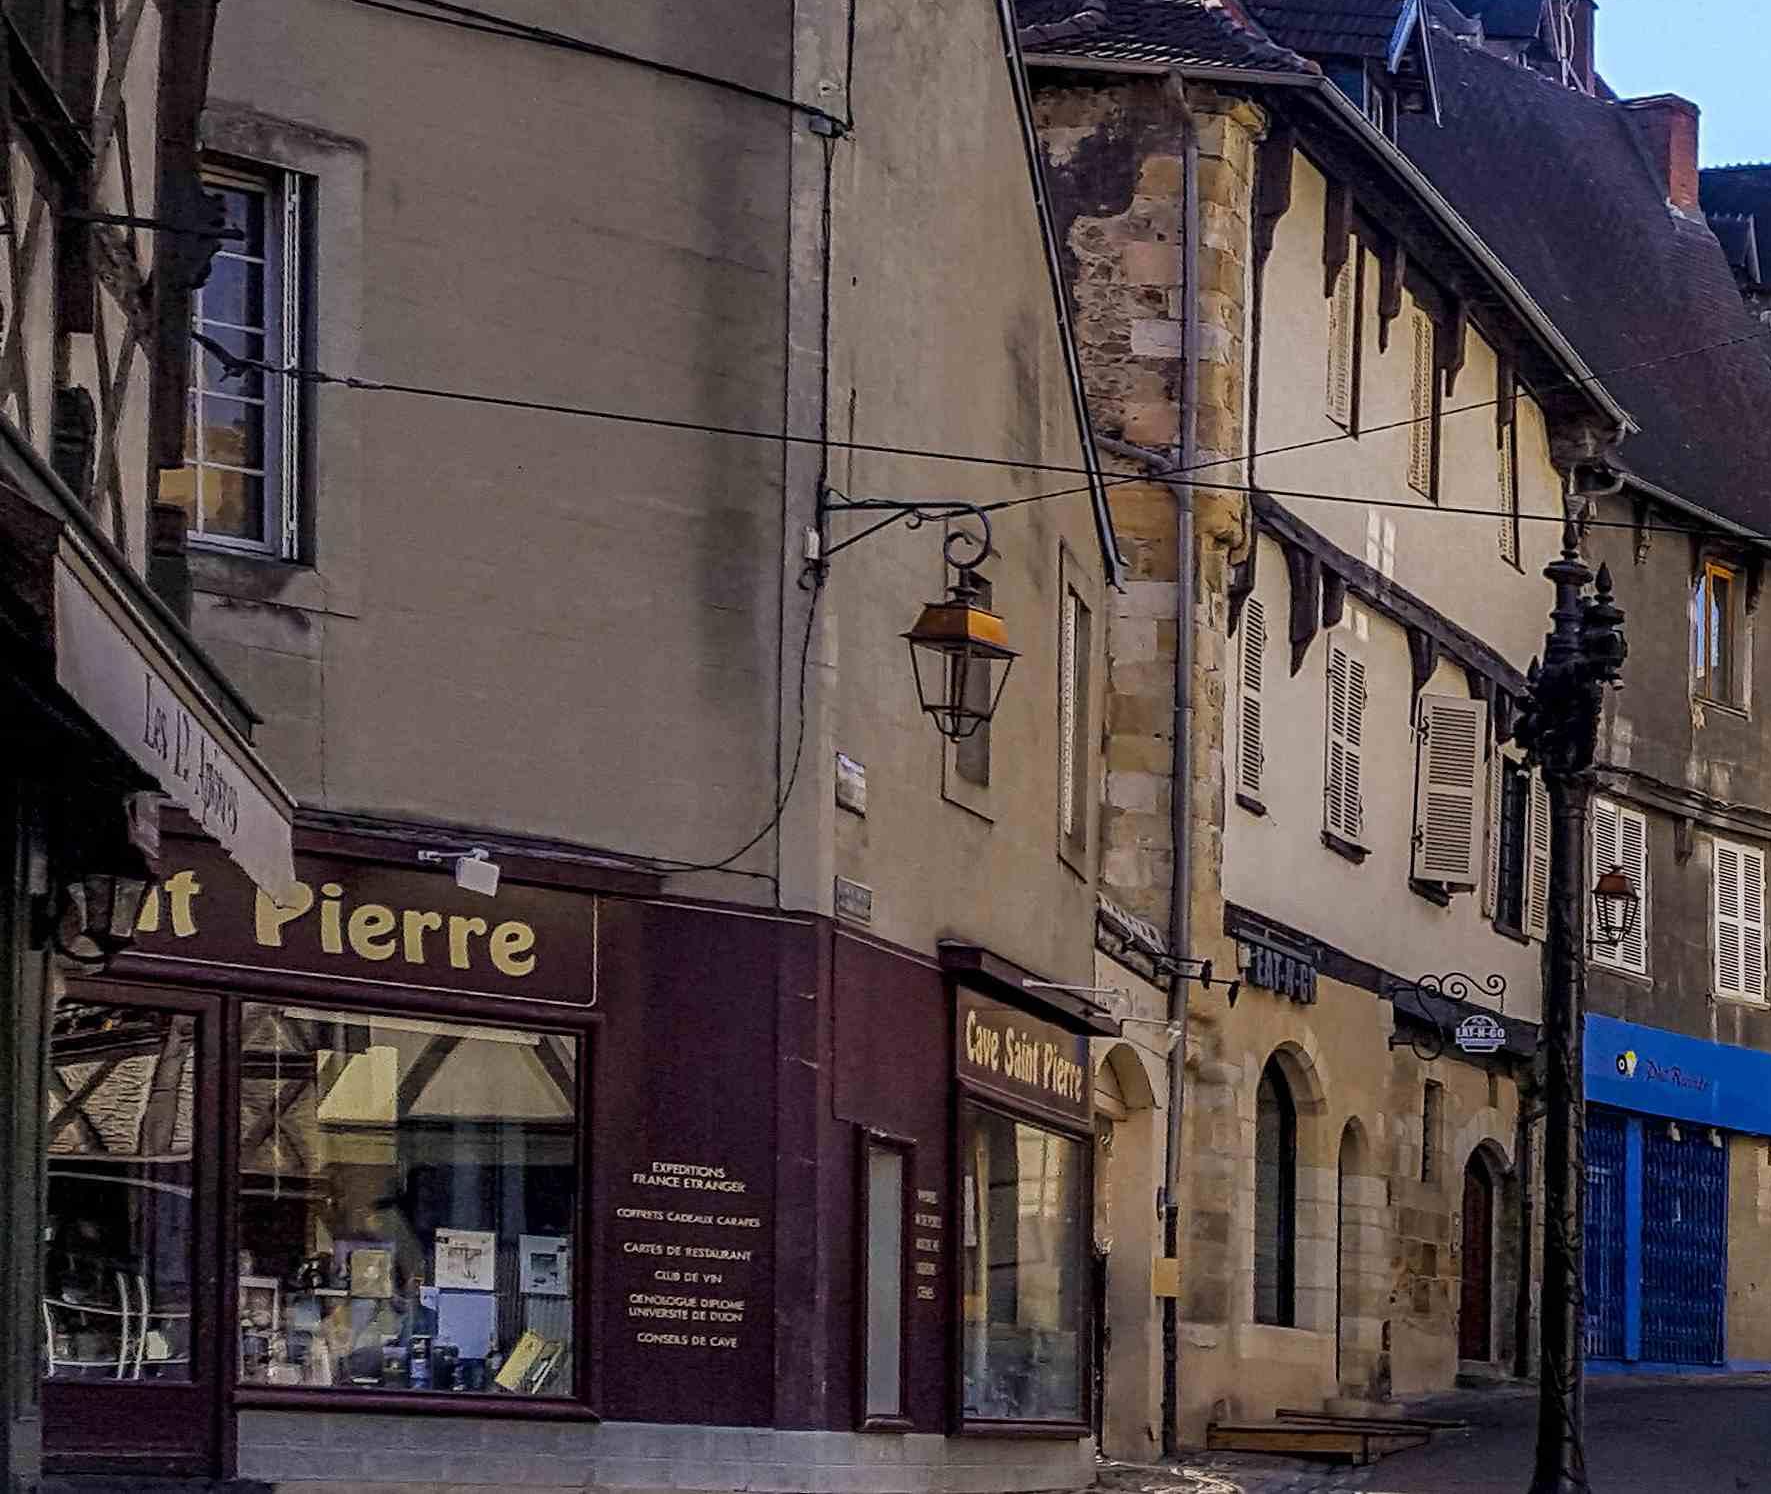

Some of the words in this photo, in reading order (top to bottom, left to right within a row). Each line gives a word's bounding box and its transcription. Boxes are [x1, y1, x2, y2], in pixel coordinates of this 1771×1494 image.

[254, 880, 536, 977] Pierre
[966, 1010, 999, 1071] Cave
[1005, 1027, 1039, 1085] Saint
[1043, 1042, 1082, 1103] Pierre
[652, 1162, 725, 1179] EXPEDITIONS
[632, 1173, 680, 1188] FRANCE
[667, 1246, 681, 1256] DE
[710, 1337, 737, 1348] CAVE
